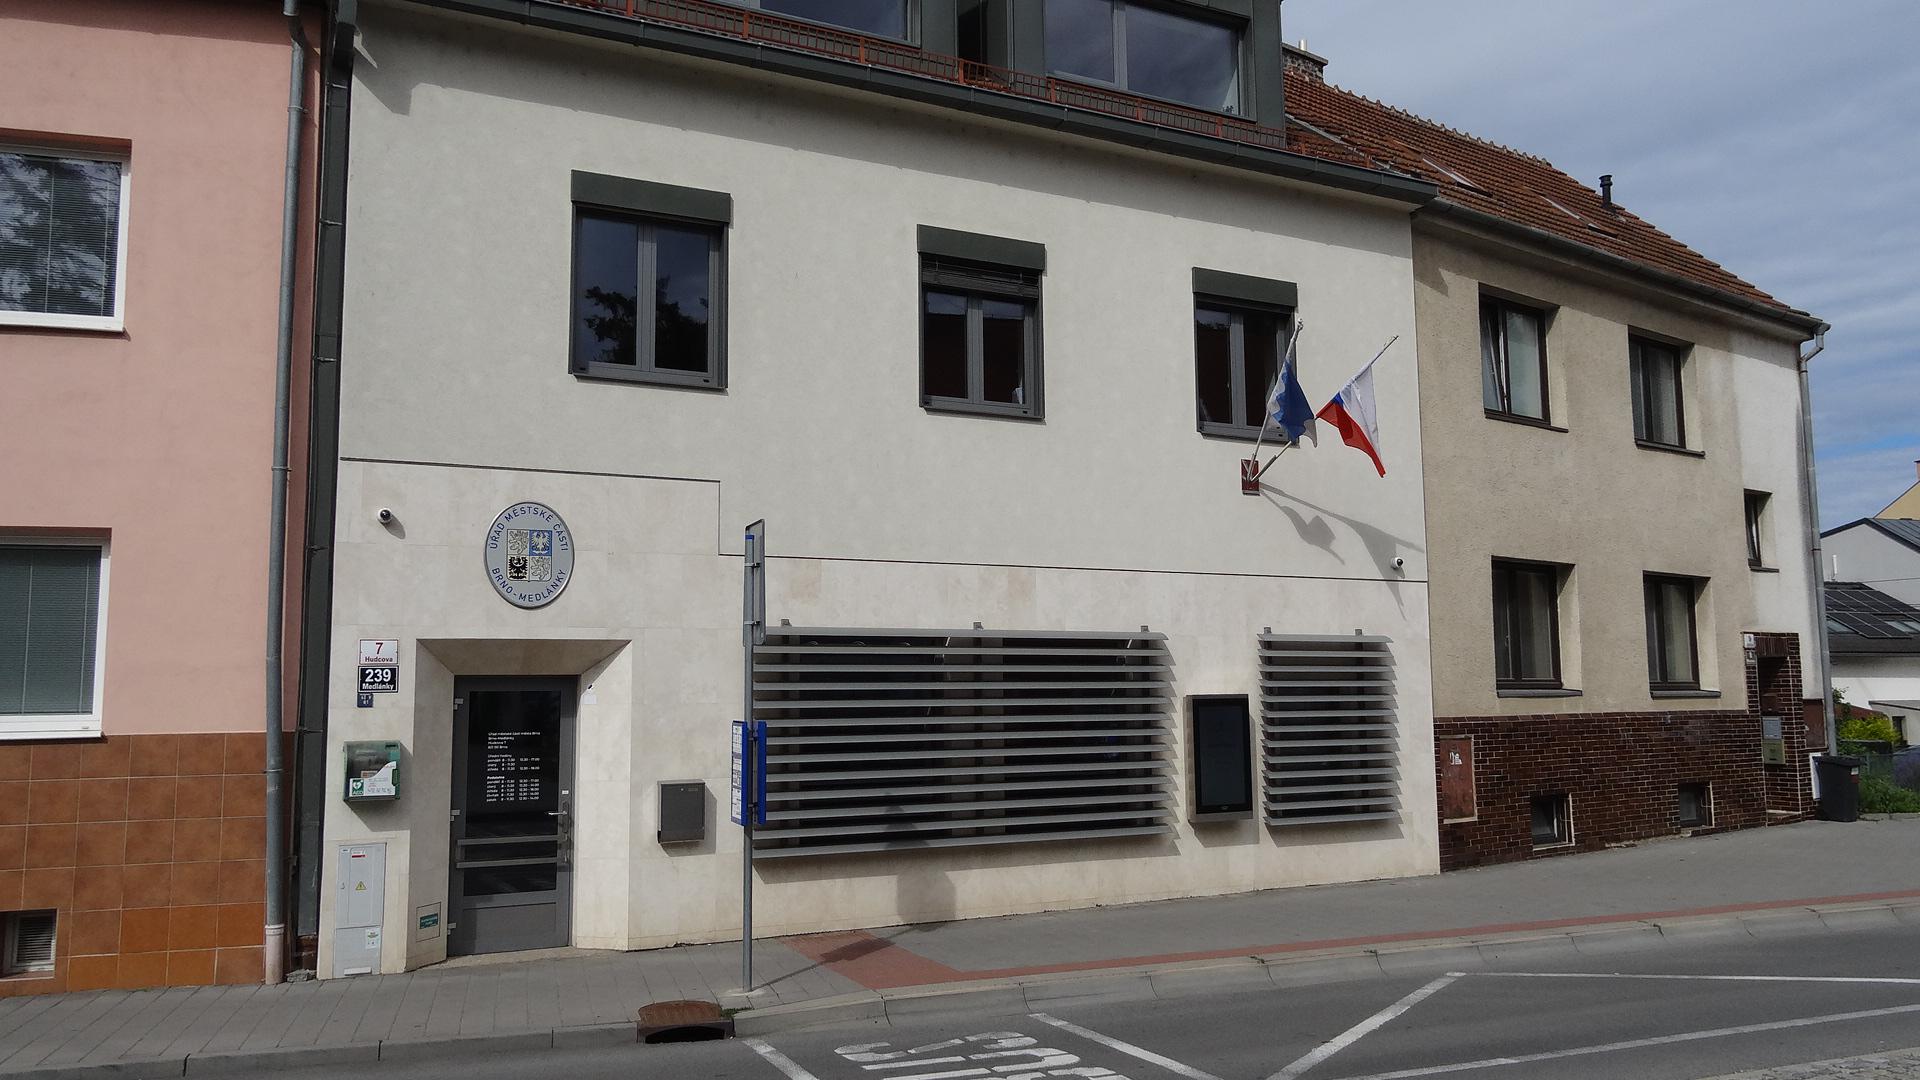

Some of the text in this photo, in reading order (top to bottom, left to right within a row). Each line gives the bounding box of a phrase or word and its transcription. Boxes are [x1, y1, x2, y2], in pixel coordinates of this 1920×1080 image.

[504, 506, 554, 523] MĚSTSKÉ
[375, 642, 384, 655] 7
[364, 669, 392, 682] 239
